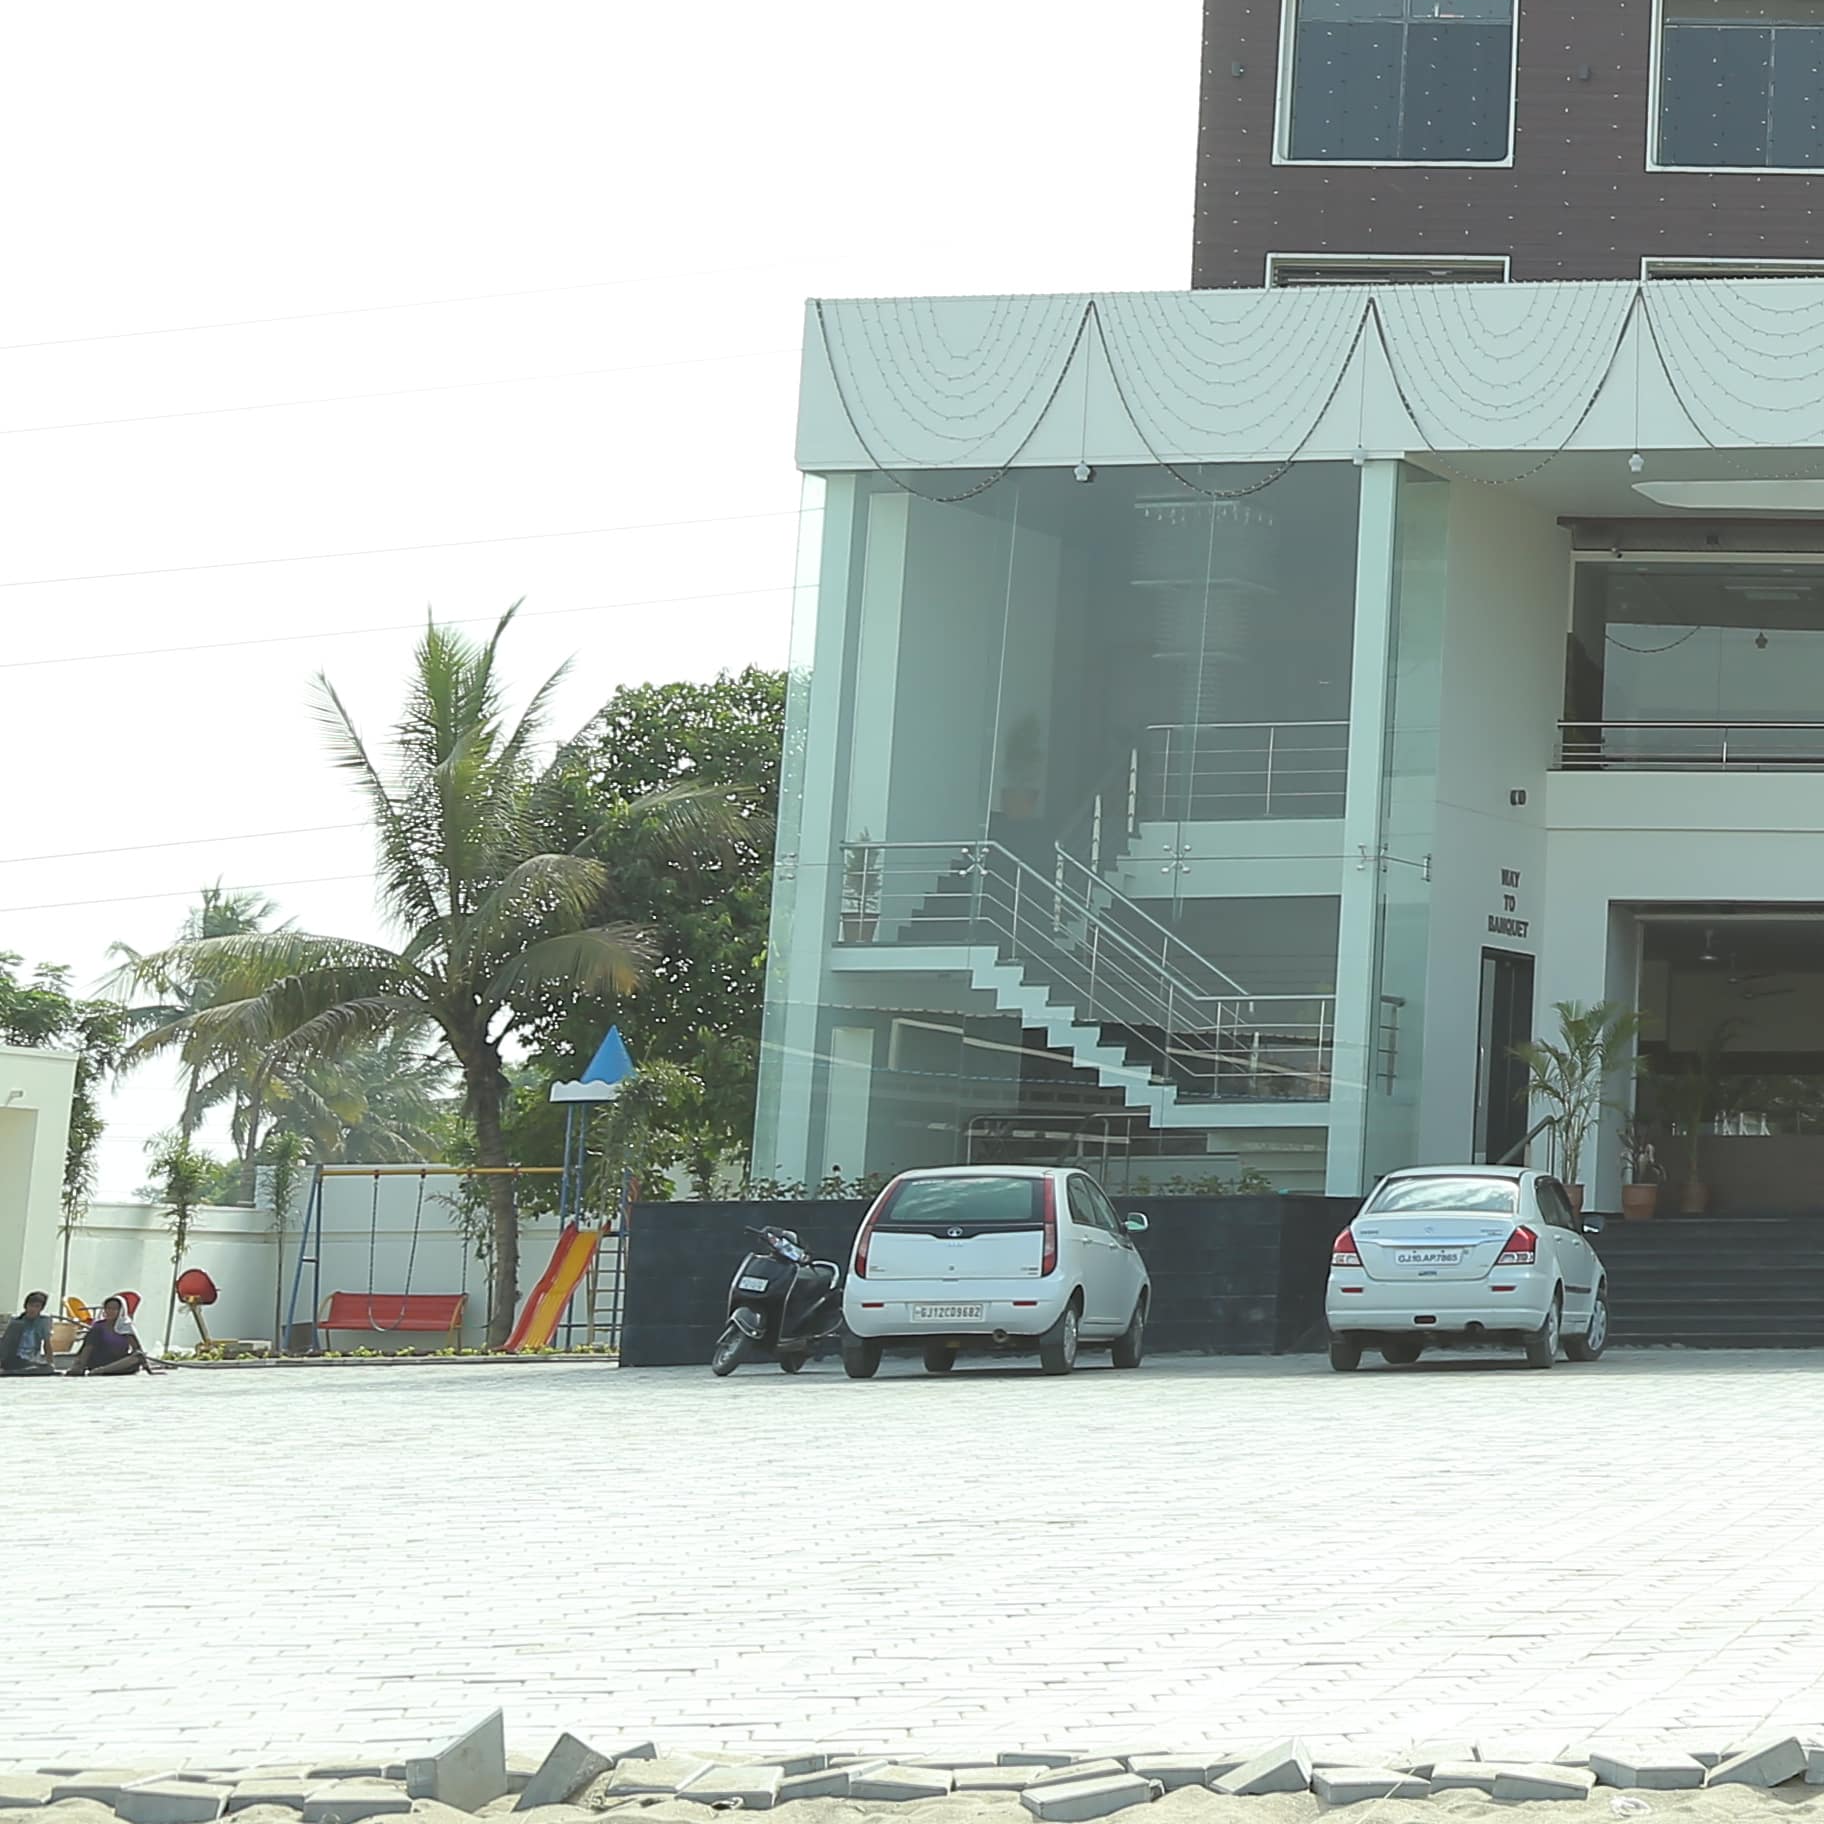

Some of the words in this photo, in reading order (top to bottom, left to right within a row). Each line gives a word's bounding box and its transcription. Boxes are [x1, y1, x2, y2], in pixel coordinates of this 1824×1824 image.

[1500, 868, 1521, 888] WAY
[1503, 894, 1516, 912] TO
[1487, 914, 1530, 938] BANQUET
